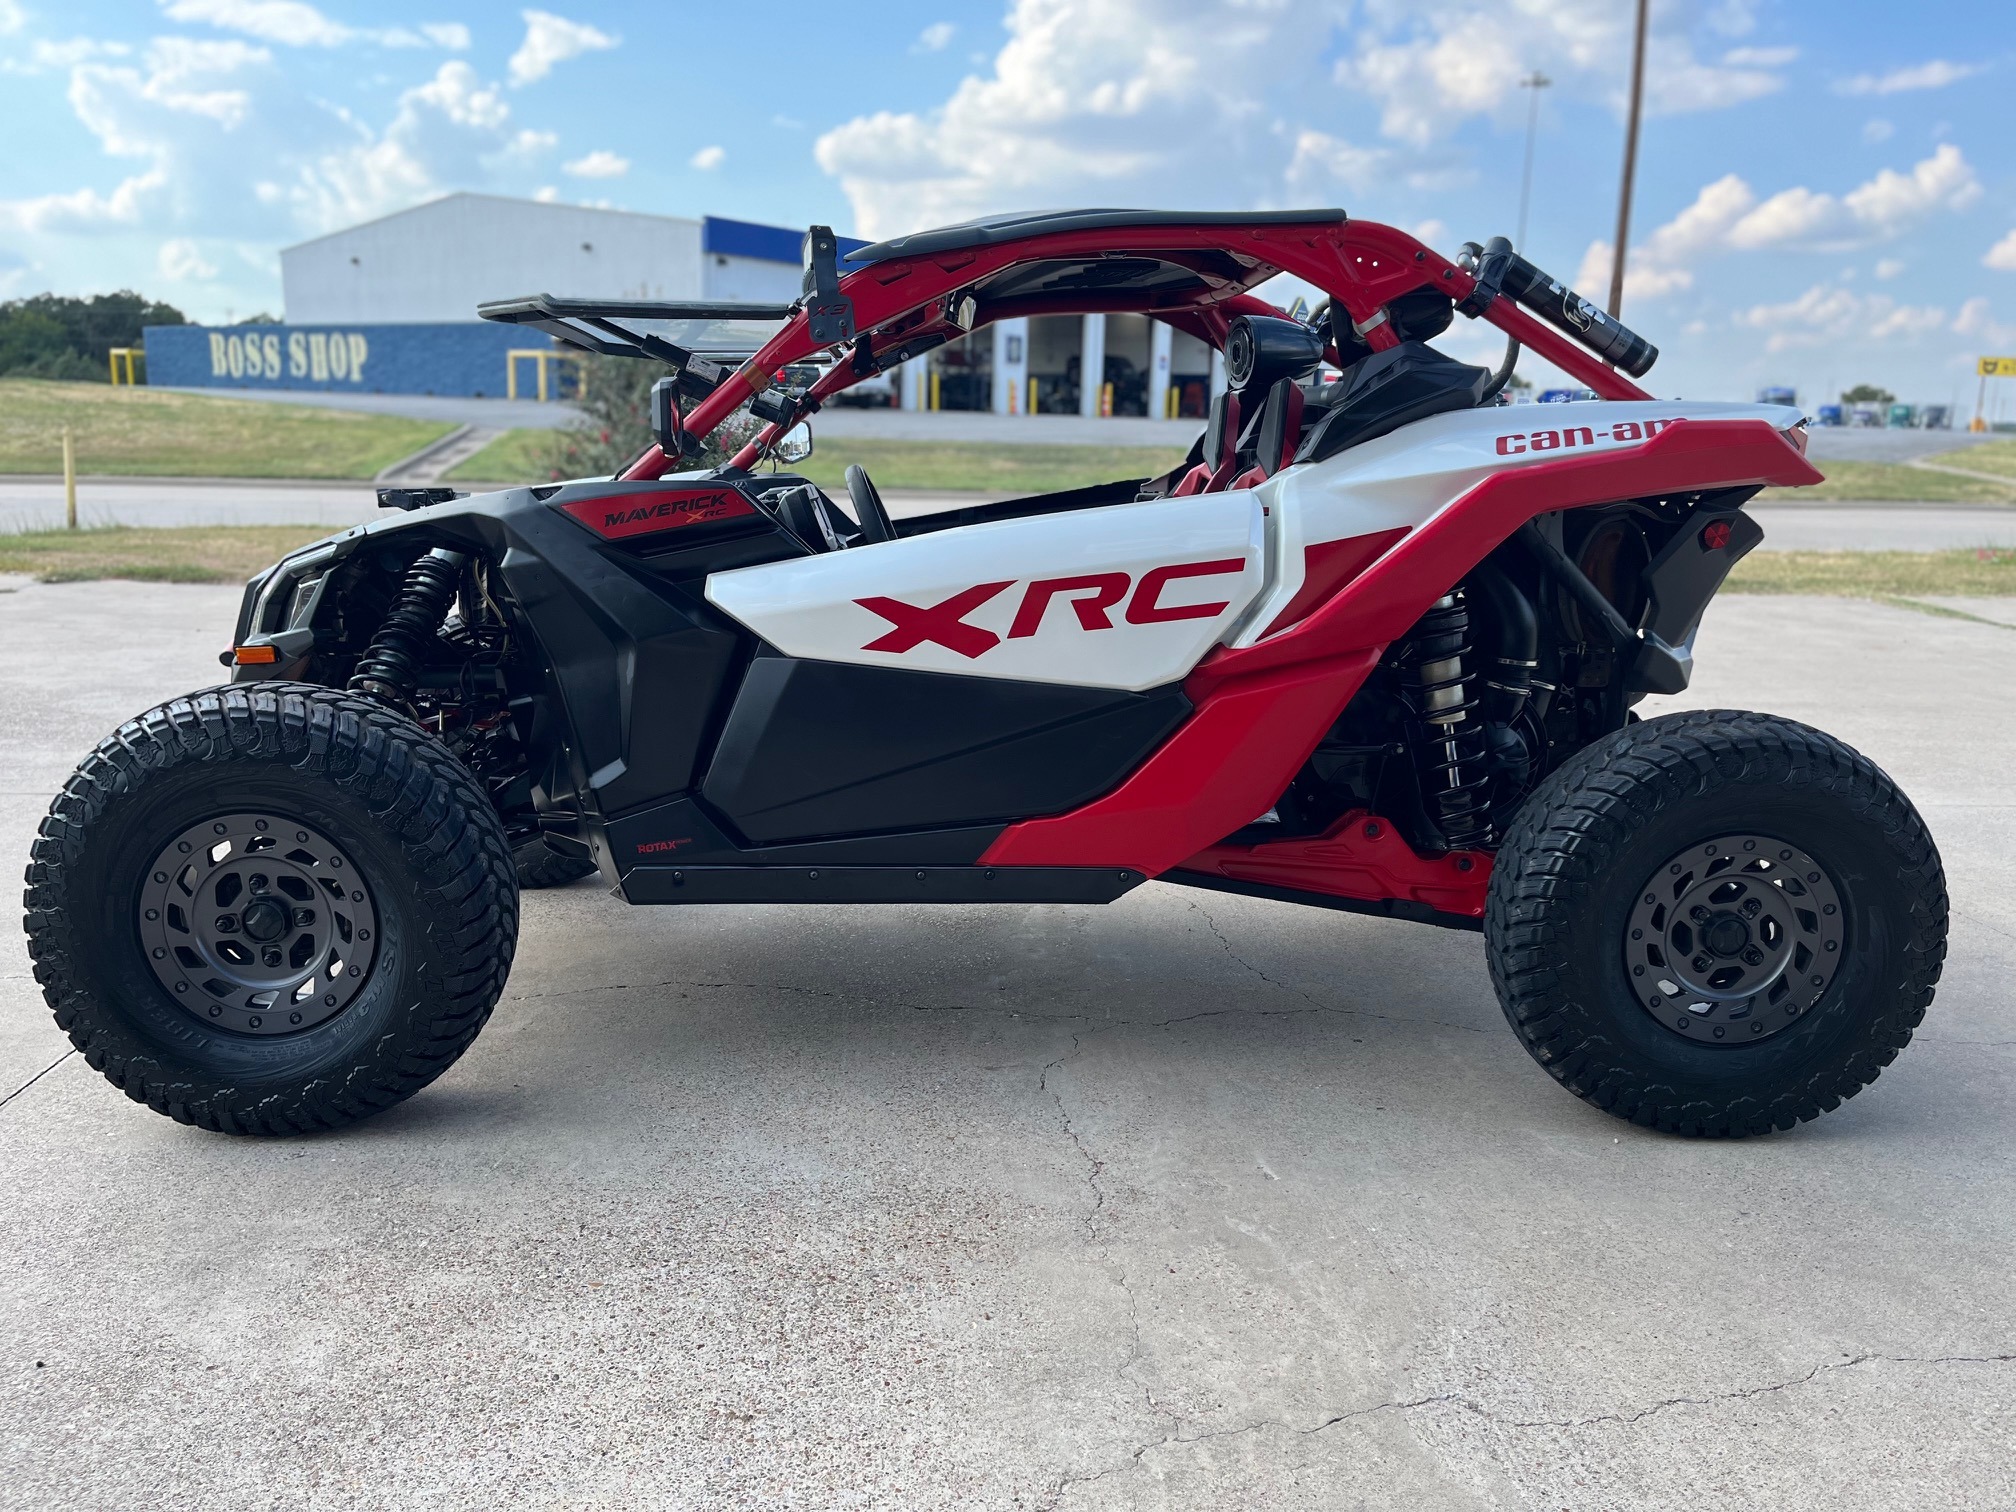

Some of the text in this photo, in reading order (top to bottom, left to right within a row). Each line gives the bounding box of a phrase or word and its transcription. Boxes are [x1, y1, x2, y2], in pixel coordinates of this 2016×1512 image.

[811, 303, 849, 318] X3
[209, 331, 368, 383] BOSS SHOP
[604, 492, 728, 528] MAVERICK
[685, 508, 728, 524] XRC
[851, 557, 1247, 660] XRC
[637, 841, 677, 854] ROTAX
